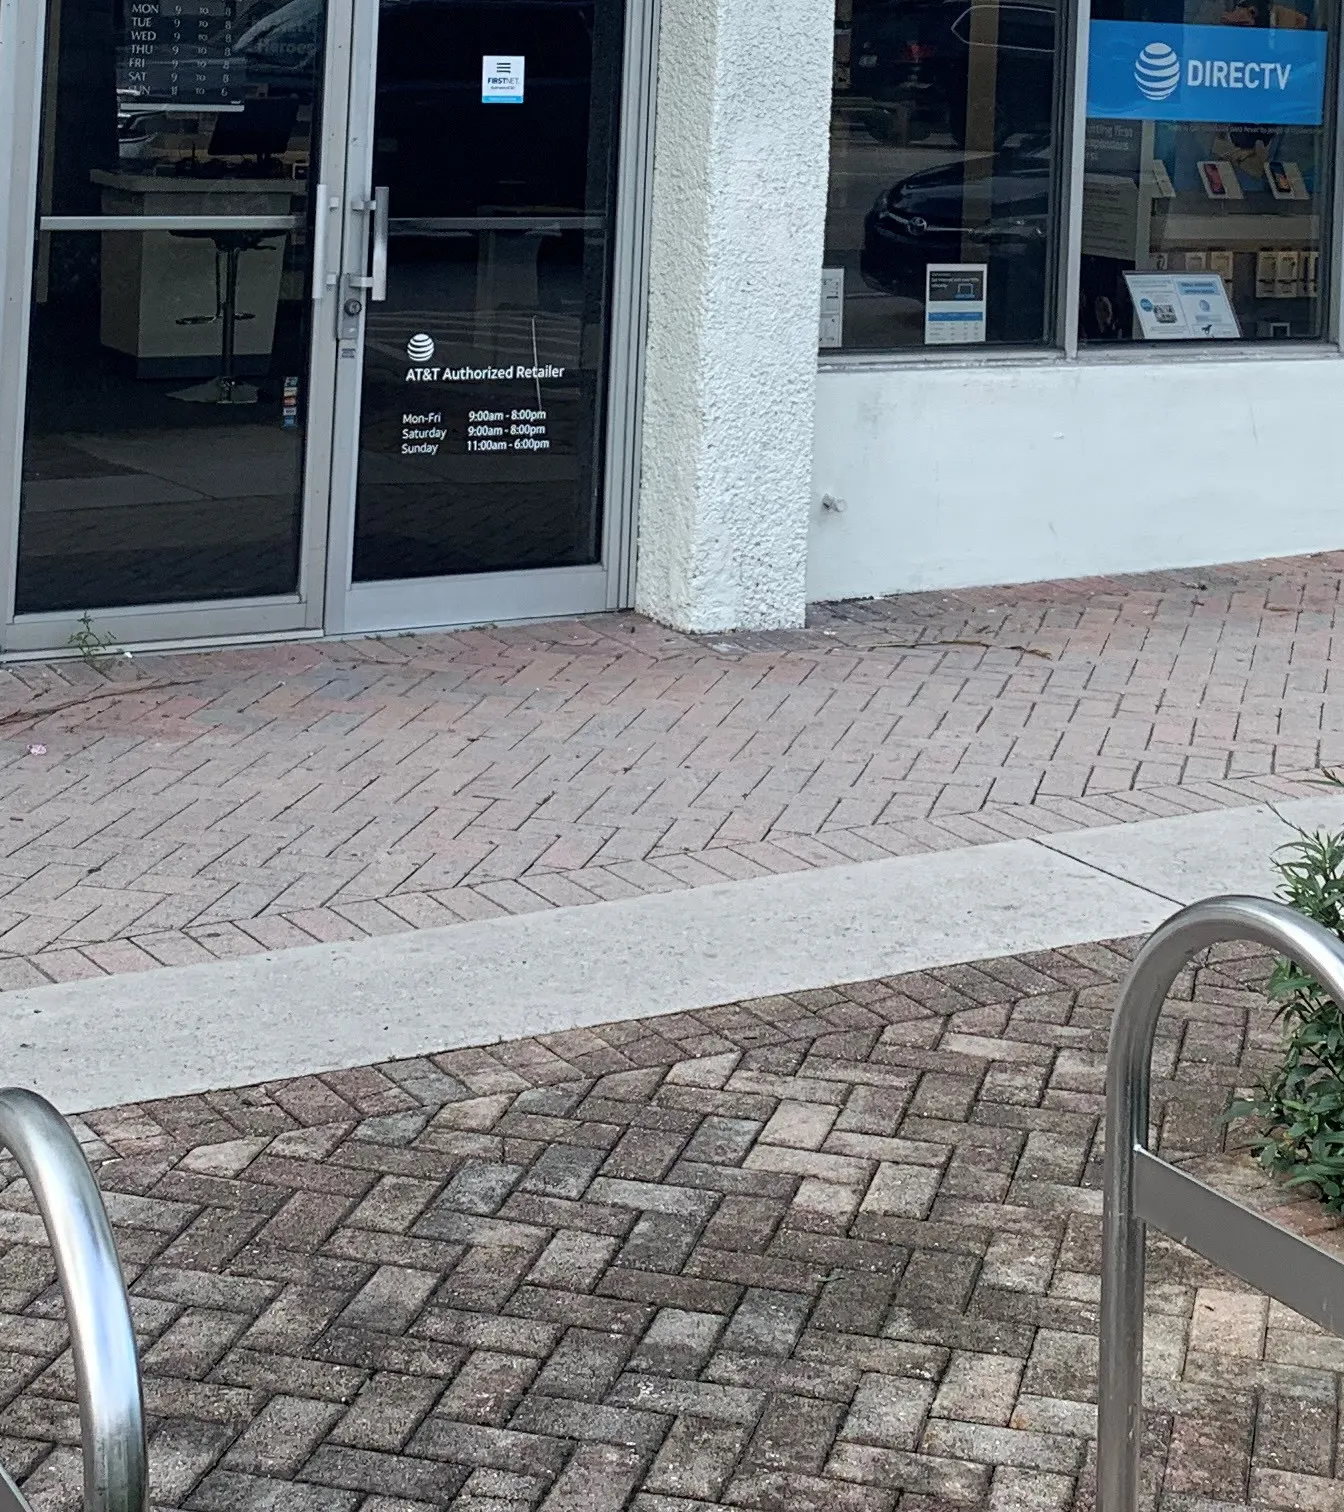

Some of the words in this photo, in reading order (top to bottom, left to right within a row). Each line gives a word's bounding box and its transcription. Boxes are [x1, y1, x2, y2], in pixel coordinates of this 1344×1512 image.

[131, 4, 159, 14] MON
[132, 17, 152, 27] TUE
[173, 19, 180, 28] 9
[131, 31, 156, 41] WED
[131, 44, 153, 55] THU
[172, 45, 179, 55] 9
[129, 58, 145, 68] FRI
[128, 71, 147, 82] SAT
[171, 73, 178, 82] 9
[1187, 59, 1292, 91] DIRECTV
[405, 368, 440, 381] AT&T
[442, 366, 513, 380] Authorized
[516, 365, 565, 378] Retailer
[402, 412, 442, 424] Mon-Fri
[469, 410, 504, 422] 9:00am
[511, 410, 547, 423] 8:00pm
[402, 427, 447, 441] Saturday
[468, 425, 503, 437] 9:00am
[510, 424, 546, 437] 8:00pm
[401, 443, 439, 455] Sunday
[467, 440, 506, 451] 11:00am
[514, 439, 550, 451] 6:00pm
